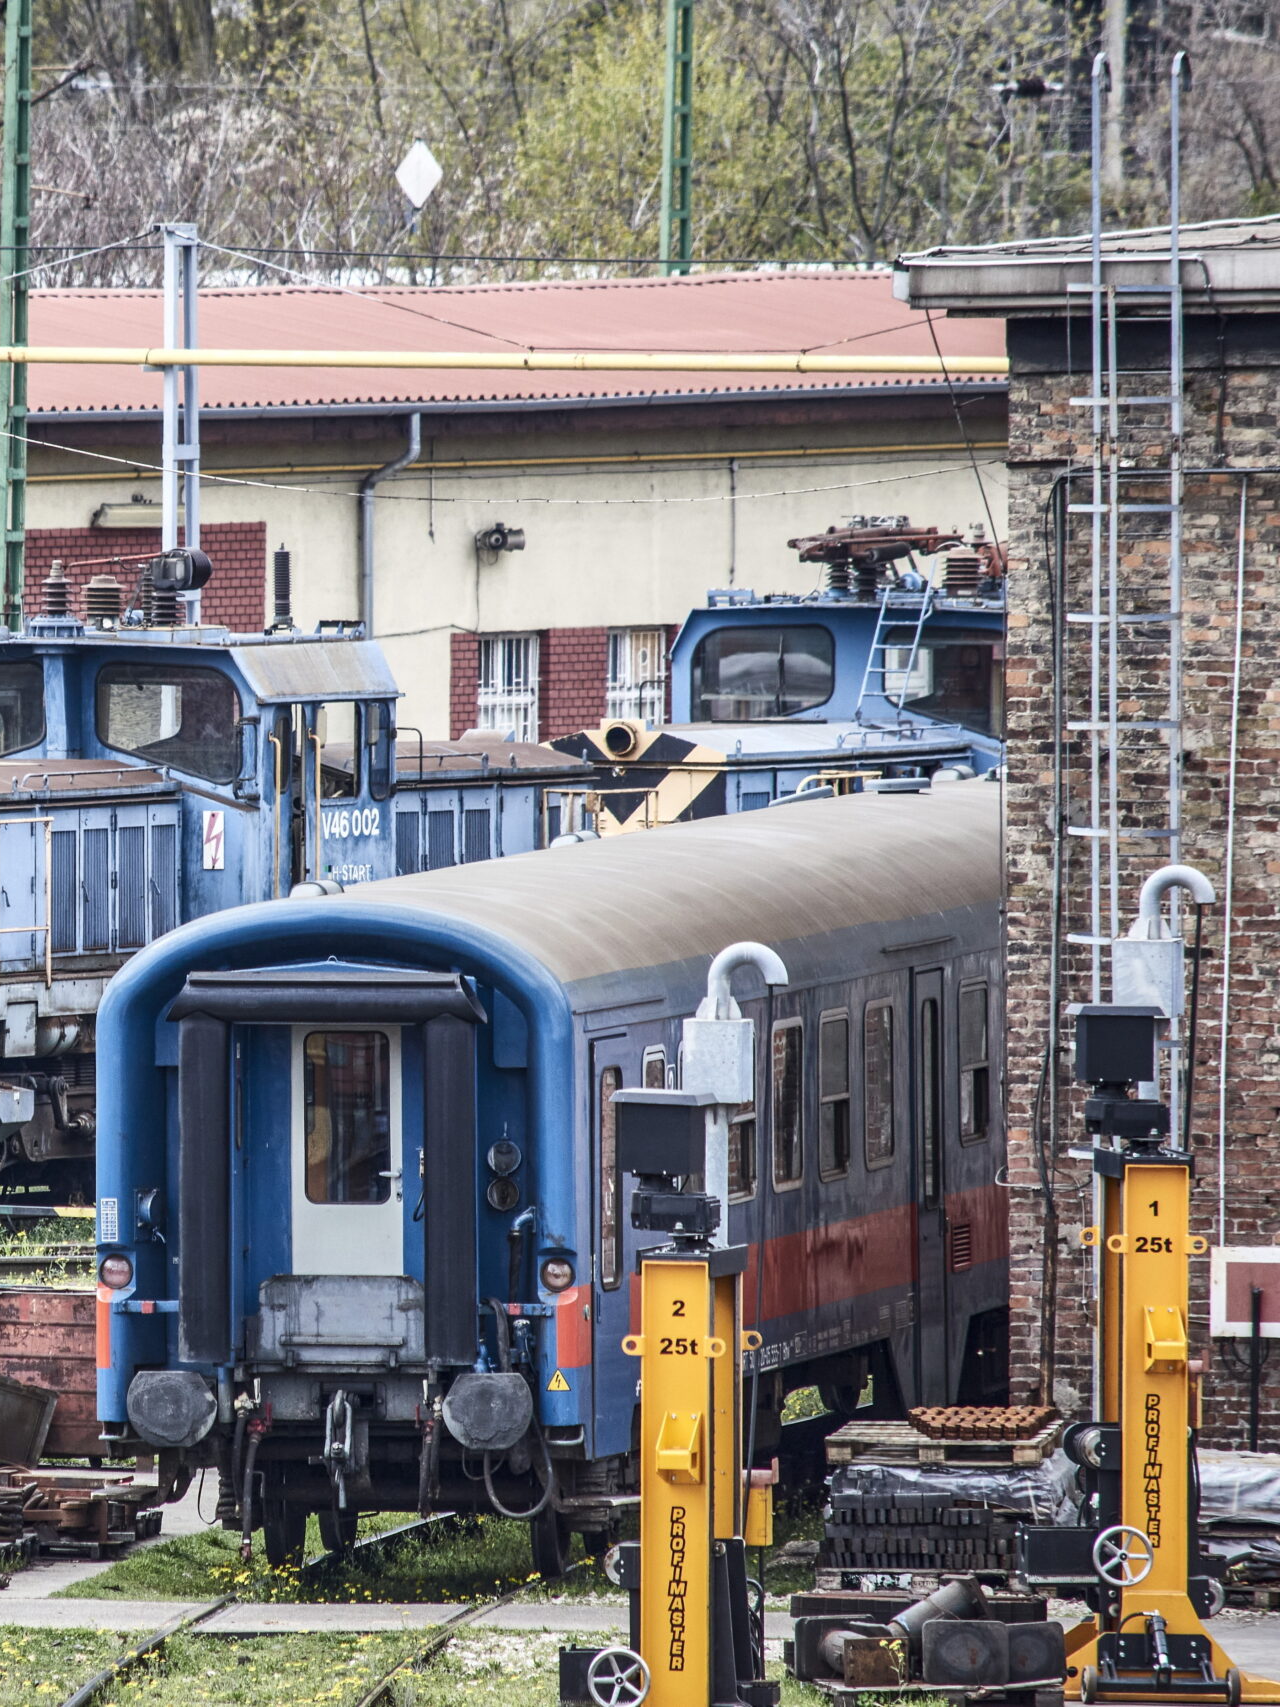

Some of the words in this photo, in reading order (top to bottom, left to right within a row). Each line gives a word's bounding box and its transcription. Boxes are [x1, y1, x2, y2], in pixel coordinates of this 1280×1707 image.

[321, 810, 350, 840] V46
[351, 808, 380, 837] 002
[332, 864, 372, 881] H-START
[1148, 1200, 1159, 1217] 1
[1135, 1236, 1173, 1253] 25t
[671, 1300, 686, 1317] 2
[660, 1338, 699, 1355] 25t
[1144, 1393, 1162, 1548] PROFIMASTER
[668, 1506, 688, 1671] PROFIMASTER
